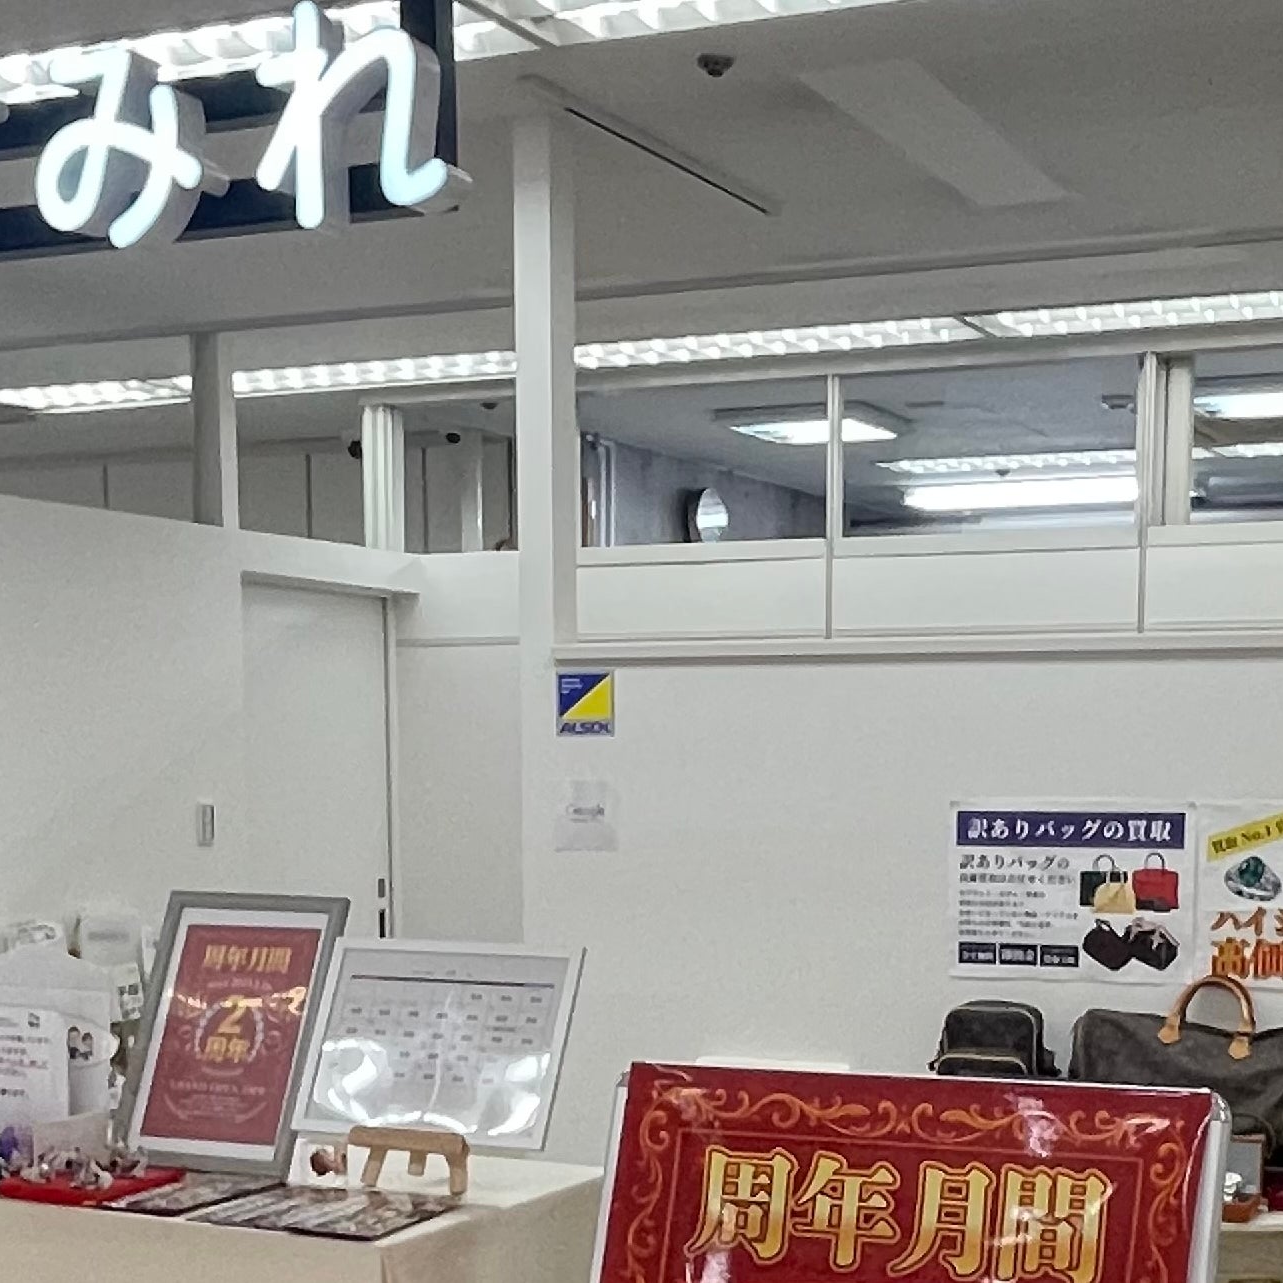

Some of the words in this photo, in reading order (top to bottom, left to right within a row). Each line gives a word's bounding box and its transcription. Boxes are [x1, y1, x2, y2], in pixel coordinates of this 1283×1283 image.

[967, 816, 1173, 843] 訳ありバッグの買取
[959, 853, 1071, 871] 訳ありバッグの
[683, 1144, 1113, 1283] 周年月間
